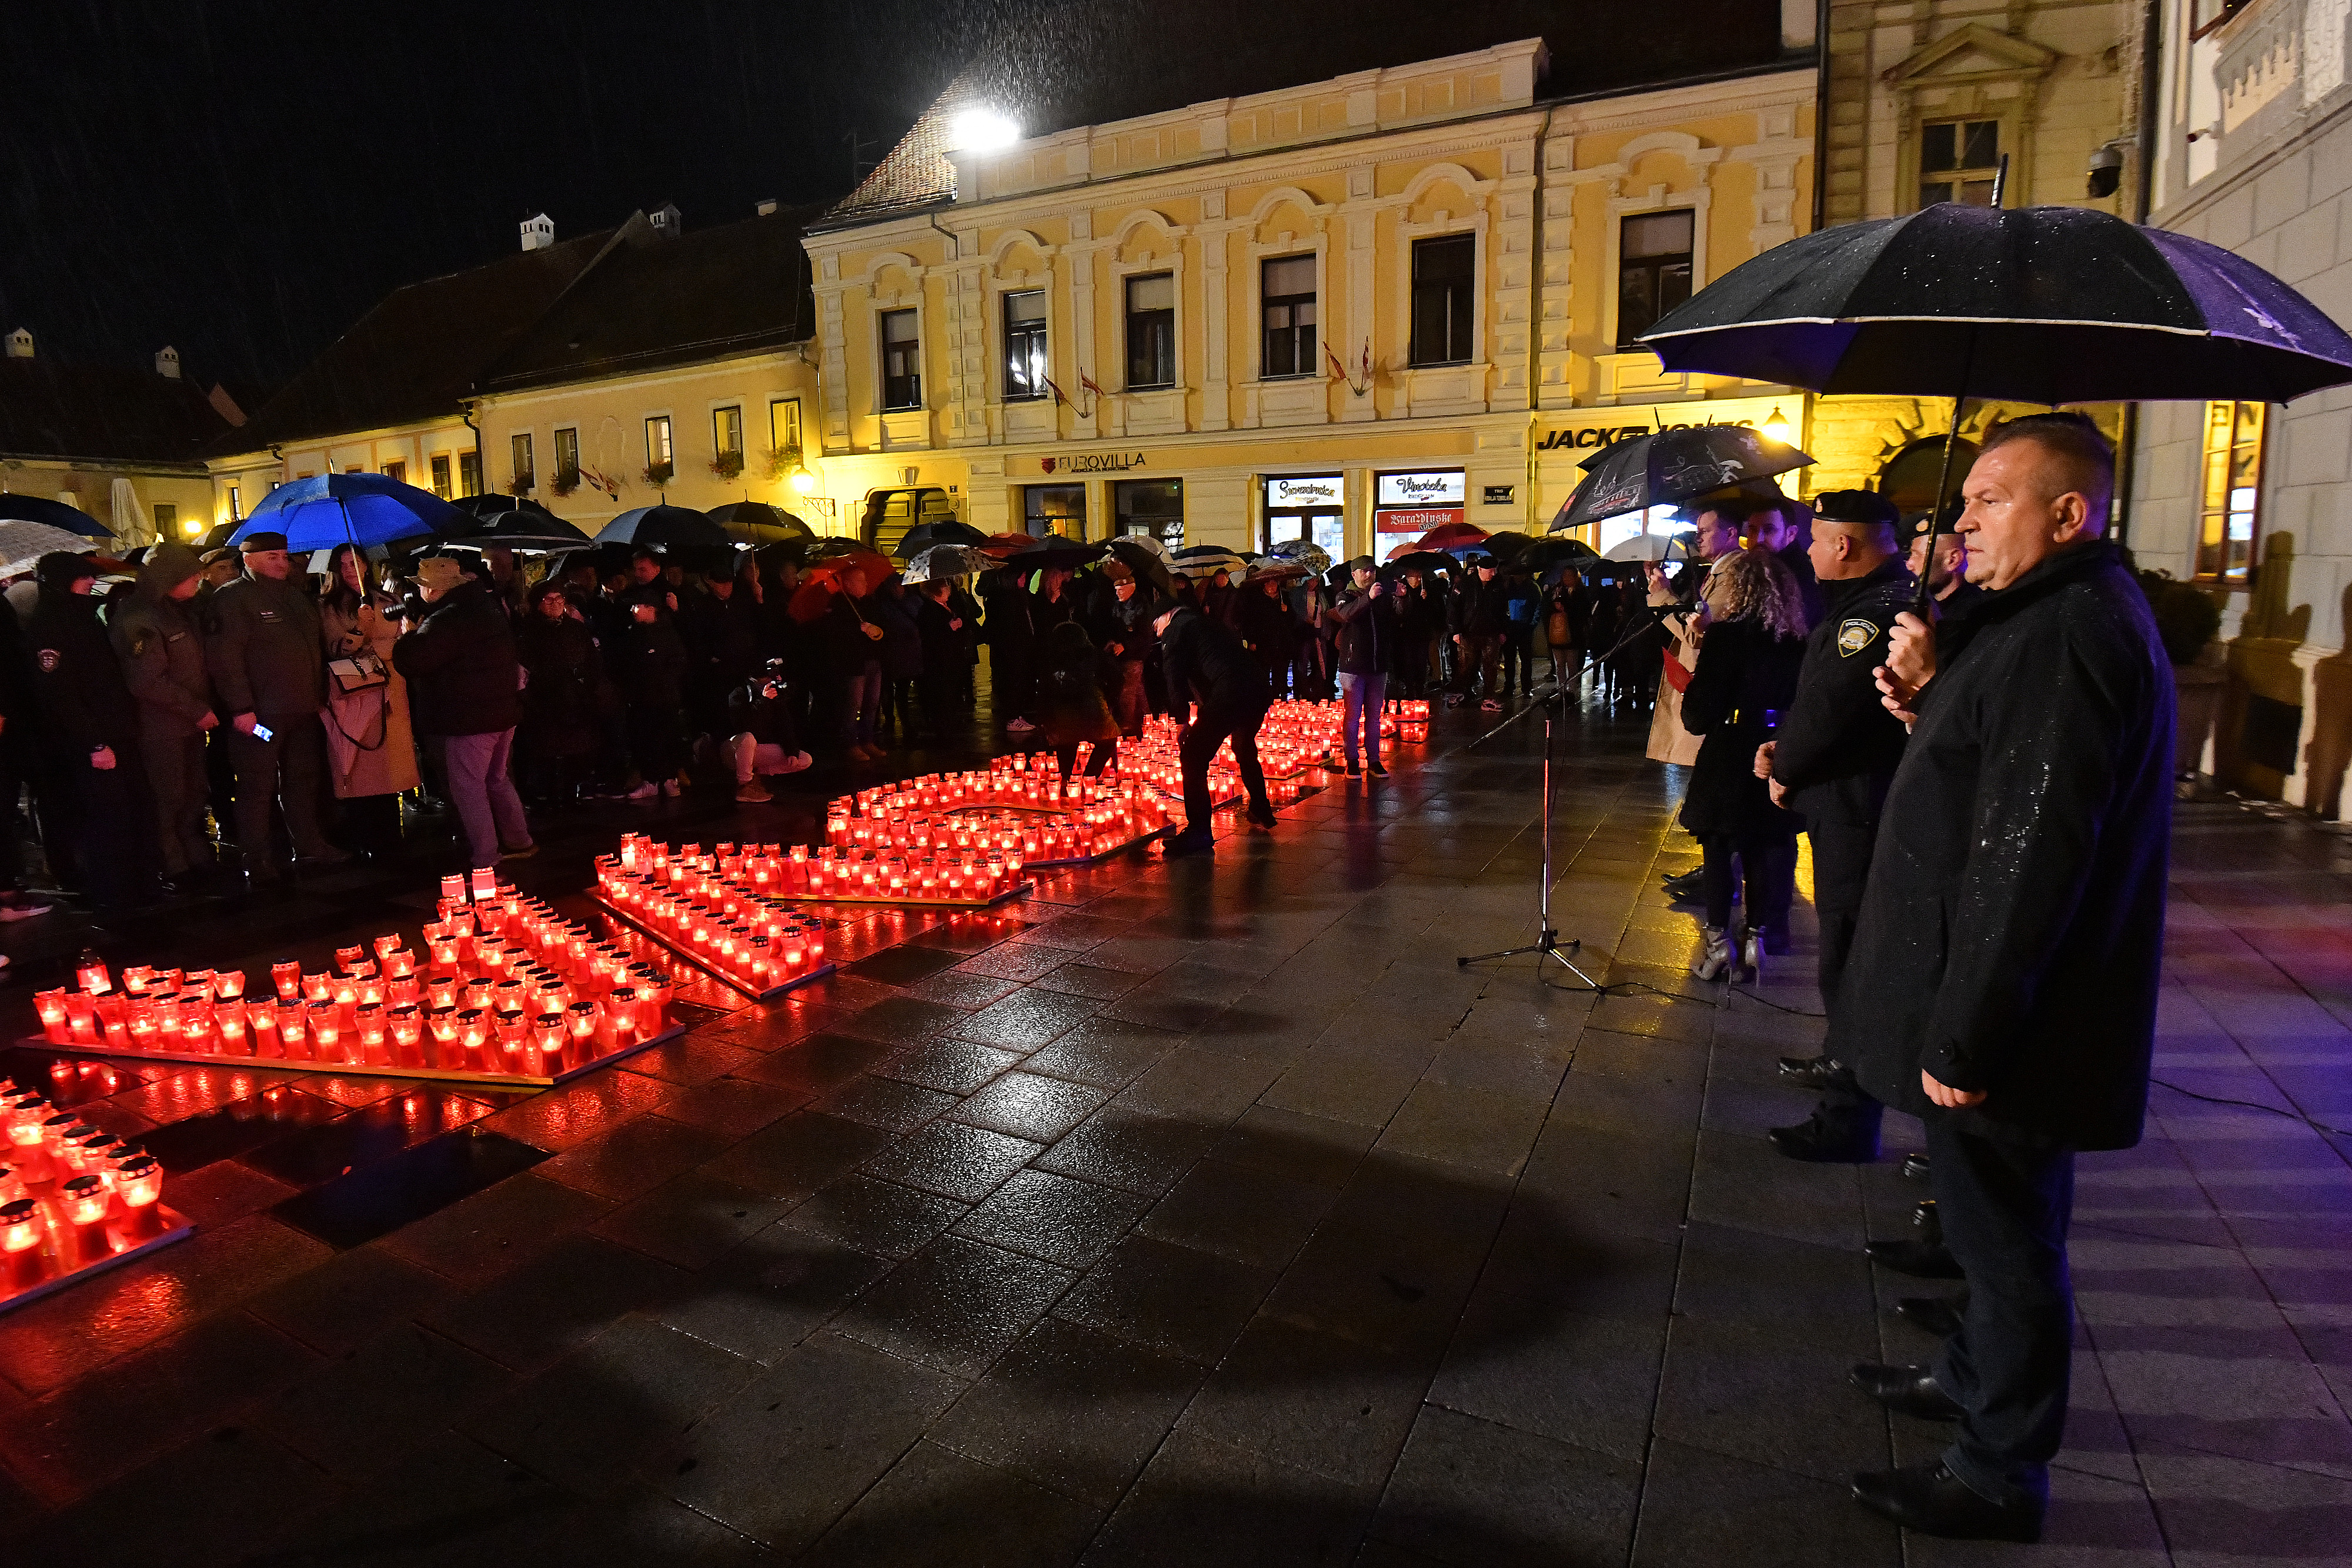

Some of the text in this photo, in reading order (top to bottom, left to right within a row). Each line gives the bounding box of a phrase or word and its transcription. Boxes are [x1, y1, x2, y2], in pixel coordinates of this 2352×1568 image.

[1538, 427, 1618, 450] JACK
[1059, 453, 1145, 469] EUROVILLA
[1396, 477, 1446, 493] Vinoteka
